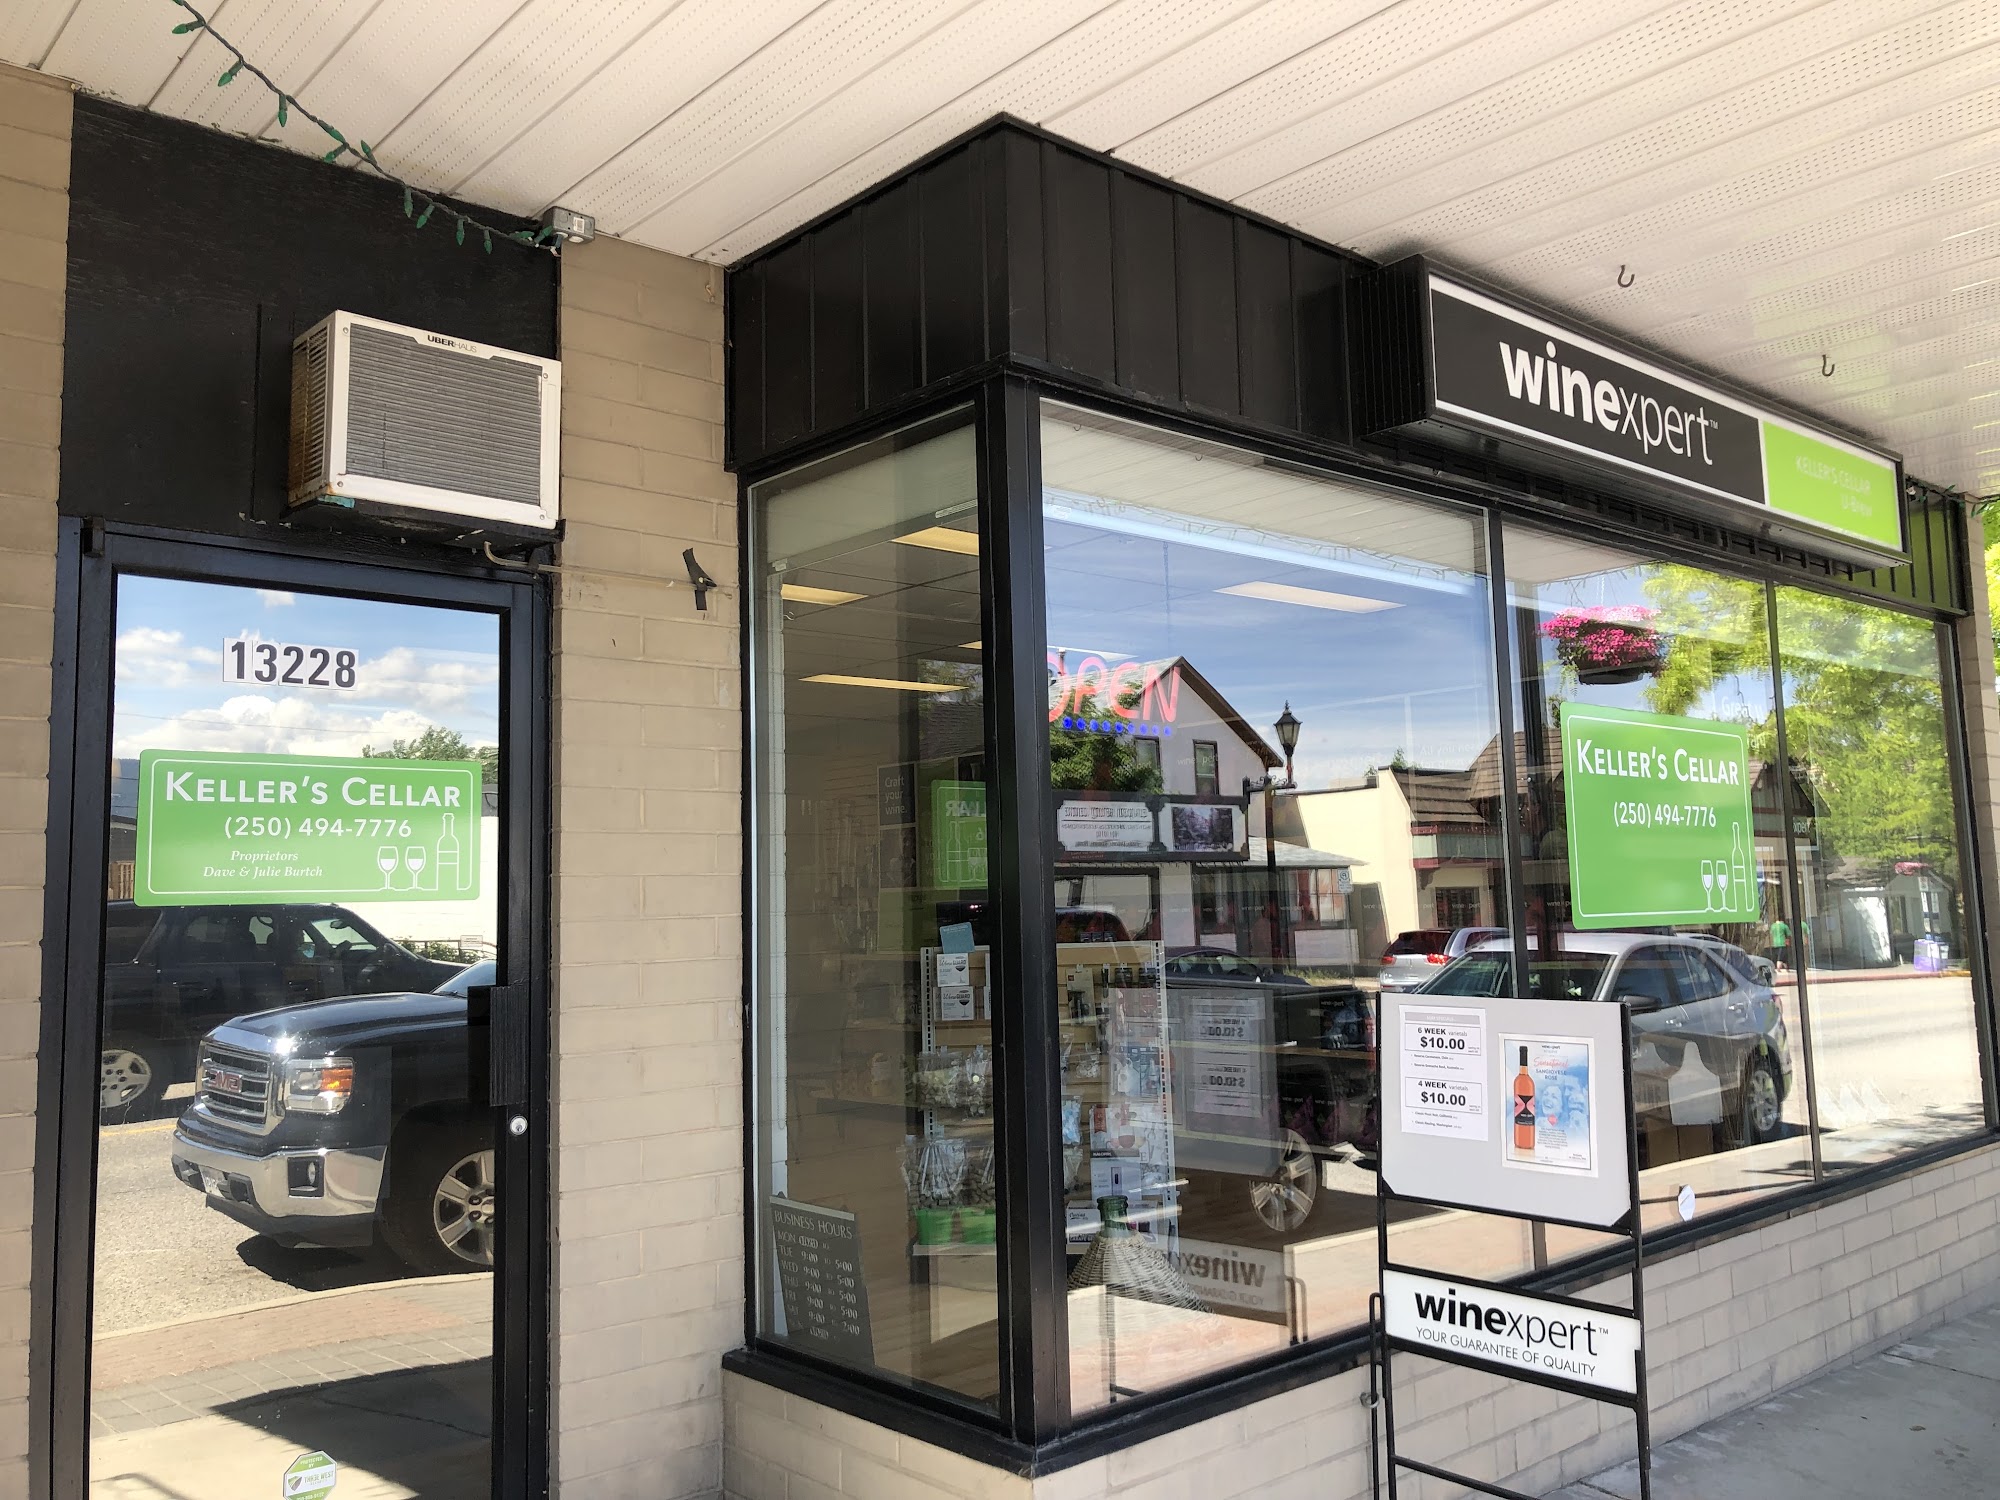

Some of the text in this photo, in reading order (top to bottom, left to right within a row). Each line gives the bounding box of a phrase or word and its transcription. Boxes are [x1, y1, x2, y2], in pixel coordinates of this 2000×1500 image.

[427, 334, 478, 353] UBERHAUS
[1499, 340, 1713, 466] winexpert
[231, 641, 356, 688] 13228
[1577, 738, 1740, 786] KELLER'S CELLAR
[166, 770, 461, 808] KELLER'S CELLAR
[884, 775, 905, 788] Craft
[885, 790, 904, 803] your
[1613, 801, 1717, 829] (250) 494-7776
[224, 816, 412, 839] (250) 494-7776
[230, 850, 299, 862] Proprietors
[203, 866, 323, 879] Dave & Julie Burtch
[1420, 1036, 1466, 1050] $10.00
[1424, 1027, 1447, 1036] WEEK
[1424, 1081, 1447, 1090] WEEK
[1448, 1084, 1469, 1092] varietals
[1420, 1091, 1466, 1106] $10.00
[774, 1210, 853, 1240] BUSINESS HOURS
[777, 1231, 796, 1244] MON
[778, 1244, 794, 1258] TUE
[801, 1251, 818, 1263] 9:00
[835, 1259, 853, 1273] 5:00
[781, 1260, 799, 1273] WED
[803, 1266, 820, 1279] 9:00
[836, 1275, 855, 1288] 5:00
[783, 1274, 799, 1287] THU
[805, 1281, 822, 1294] 9:00
[838, 1290, 857, 1304] 5:00
[807, 1296, 824, 1309] 9:00
[840, 1306, 858, 1319] 5:00
[808, 1311, 826, 1324] 9:00
[842, 1321, 860, 1335] 2:00
[1414, 1288, 1598, 1356] winexpert
[1416, 1326, 1597, 1377] YOUR GUARANTEE OF QUALITY
[300, 1456, 323, 1465] PROTECTED
